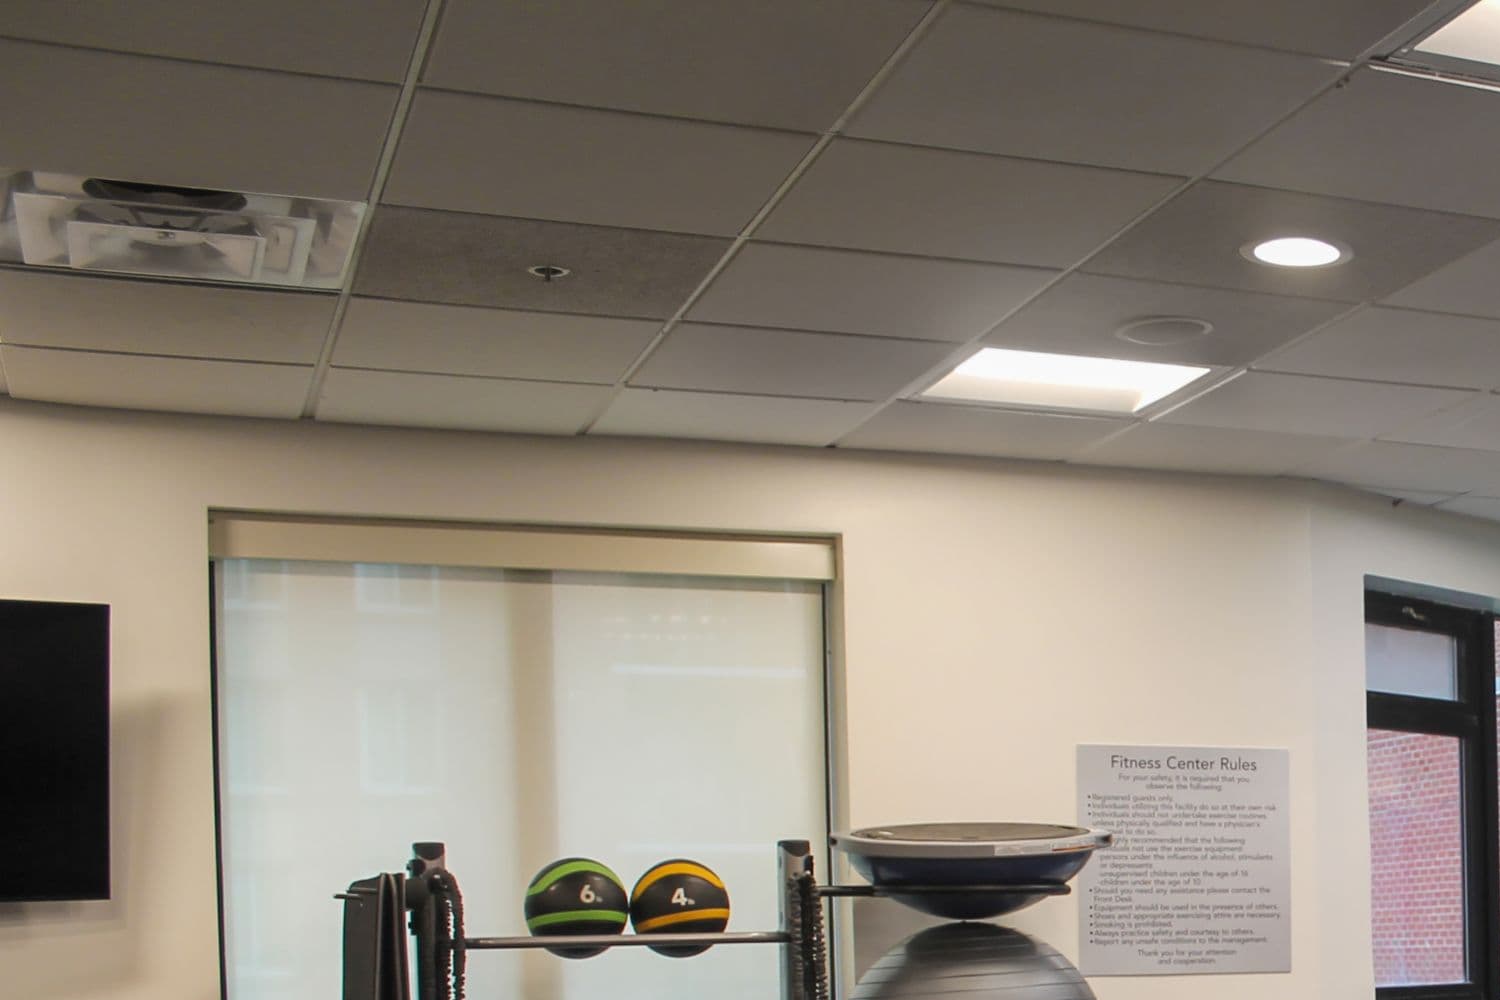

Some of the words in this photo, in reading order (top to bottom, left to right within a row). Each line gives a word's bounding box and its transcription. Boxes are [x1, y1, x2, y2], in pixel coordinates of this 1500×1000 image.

[1110, 754, 1162, 769] Fitness
[1166, 755, 1215, 770] Center
[1220, 757, 1257, 771] Rules
[580, 884, 596, 903] 6
[671, 887, 688, 906] 4
